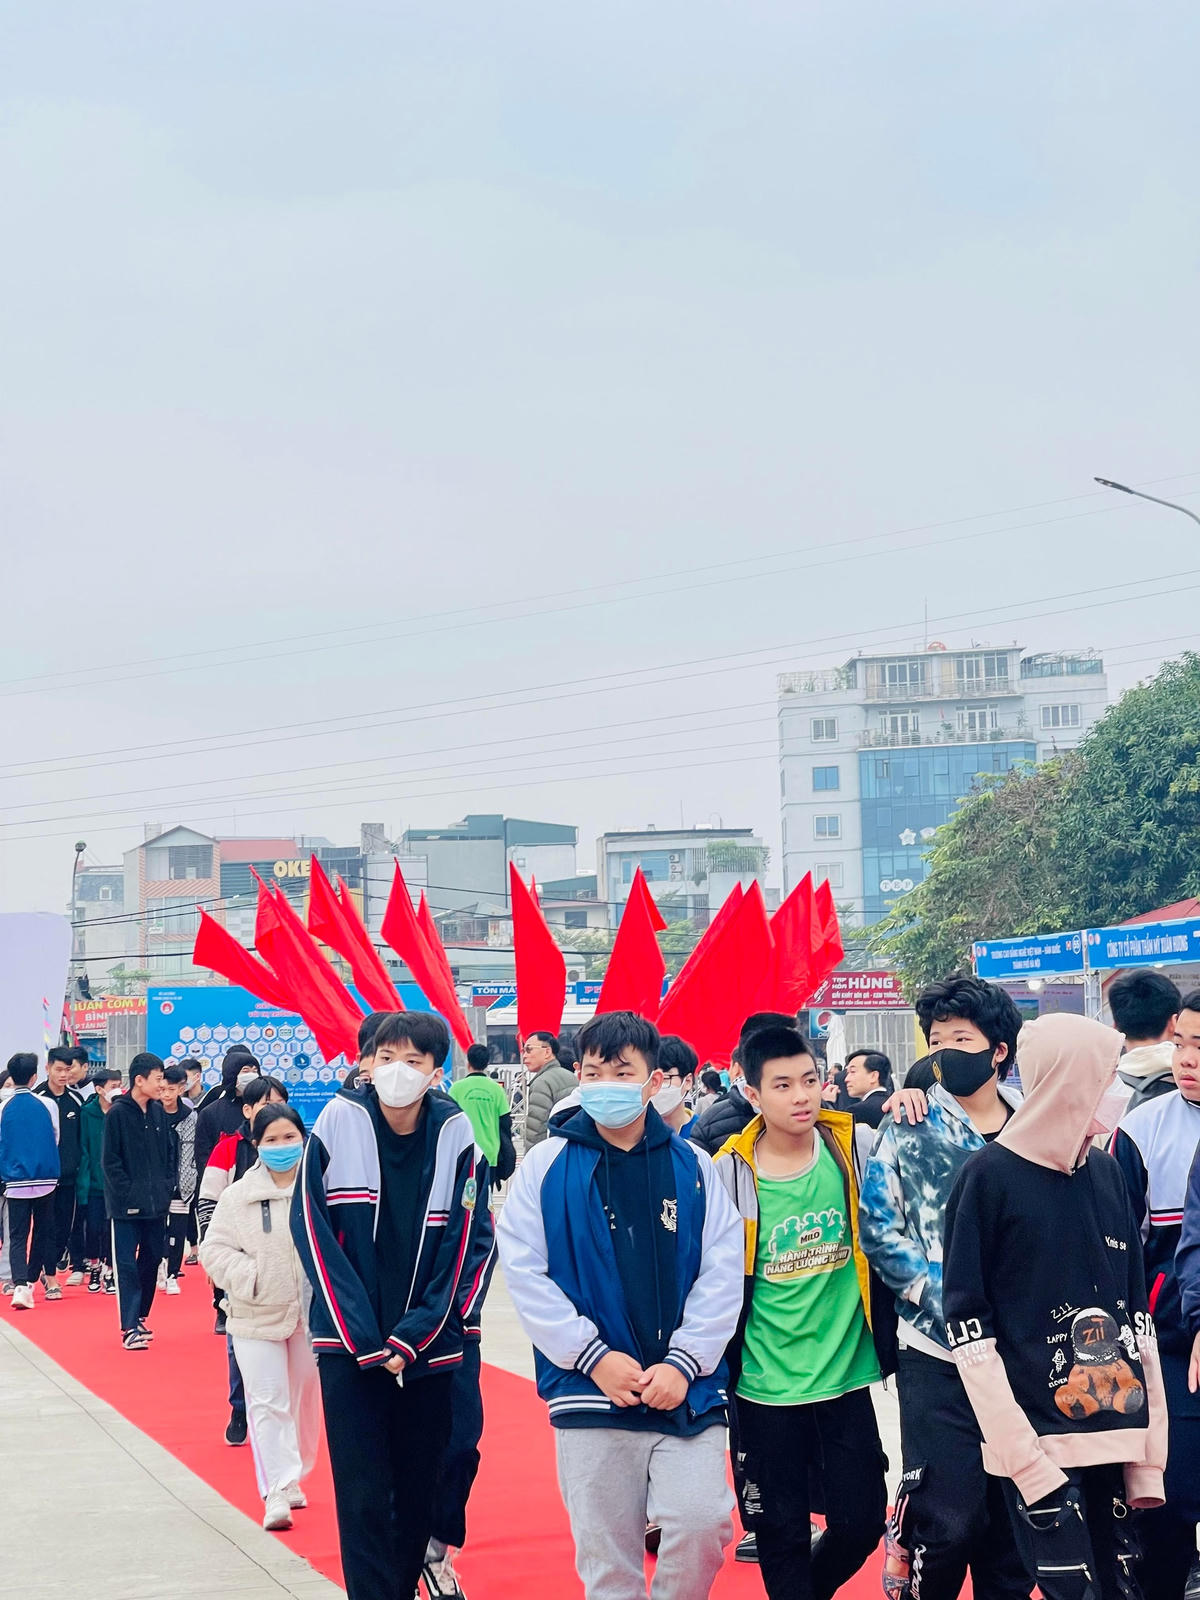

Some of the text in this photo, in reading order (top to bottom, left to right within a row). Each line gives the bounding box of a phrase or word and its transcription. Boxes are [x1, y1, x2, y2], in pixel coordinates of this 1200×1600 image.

[849, 975, 893, 989] HÙNG
[499, 985, 517, 994] MÁ
[800, 1232, 820, 1243] MILO
